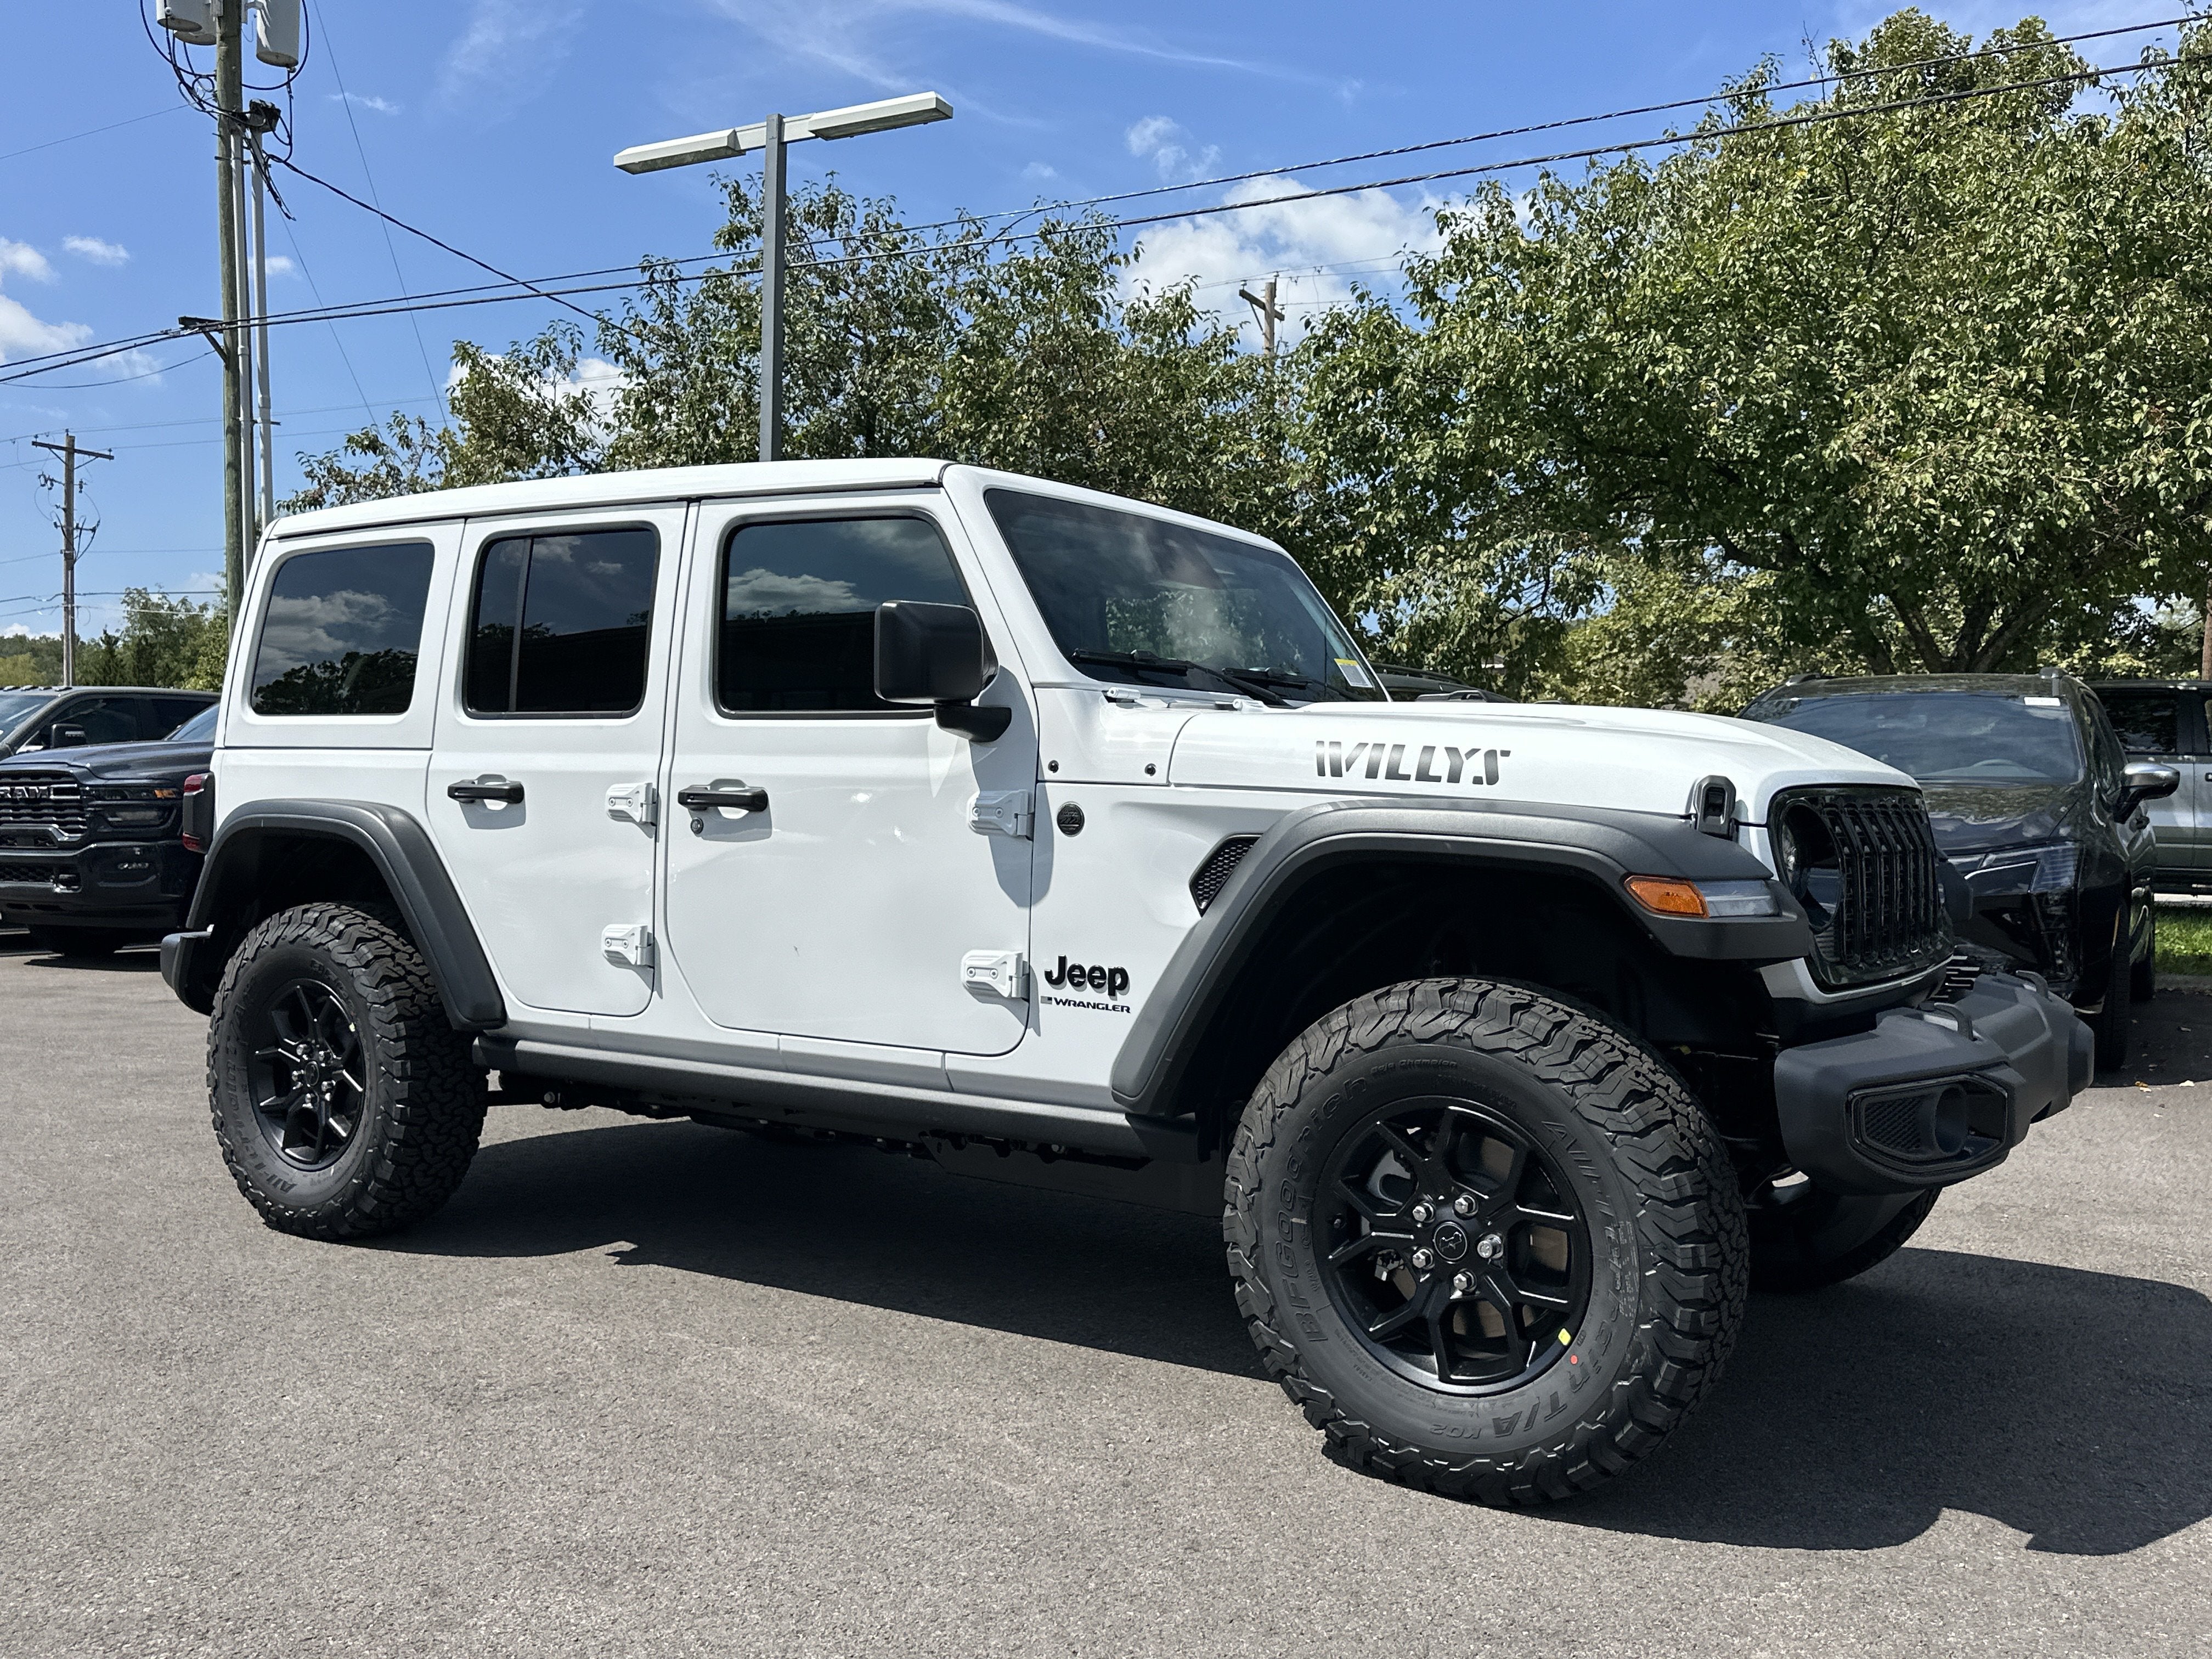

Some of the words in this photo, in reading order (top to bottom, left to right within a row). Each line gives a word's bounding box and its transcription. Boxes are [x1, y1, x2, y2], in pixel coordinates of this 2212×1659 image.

[1316, 741, 1511, 786] WILLYS
[0, 786, 48, 799] RAM
[1044, 954, 1128, 996] Jeep
[1053, 997, 1131, 1014] WRANGLER
[1274, 1076, 1367, 1342] BFGoodrich
[1492, 1391, 1567, 1438] T/A
